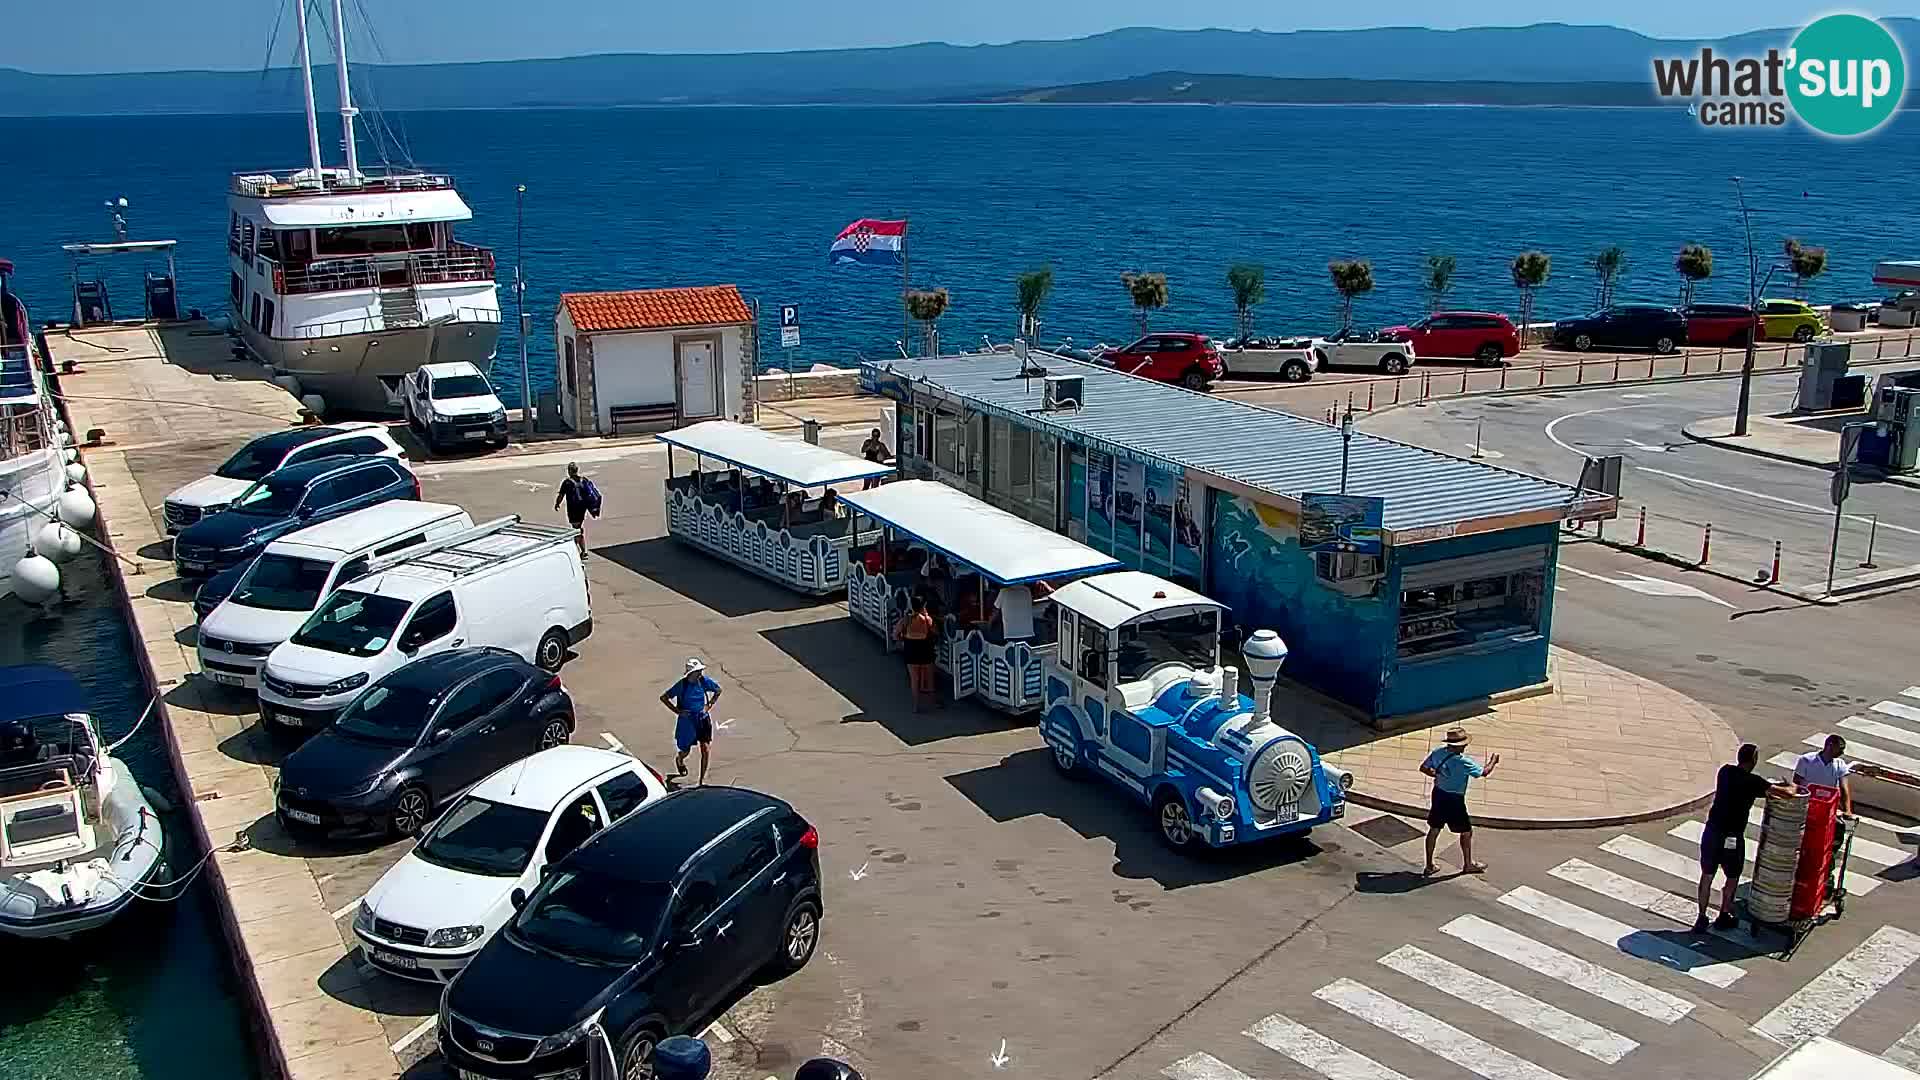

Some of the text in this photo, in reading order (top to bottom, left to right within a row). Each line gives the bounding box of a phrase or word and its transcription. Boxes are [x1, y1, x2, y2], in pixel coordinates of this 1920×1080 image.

[784, 307, 795, 325] P
[1098, 440, 1129, 457] STATION
[1155, 459, 1181, 475] OFFICE
